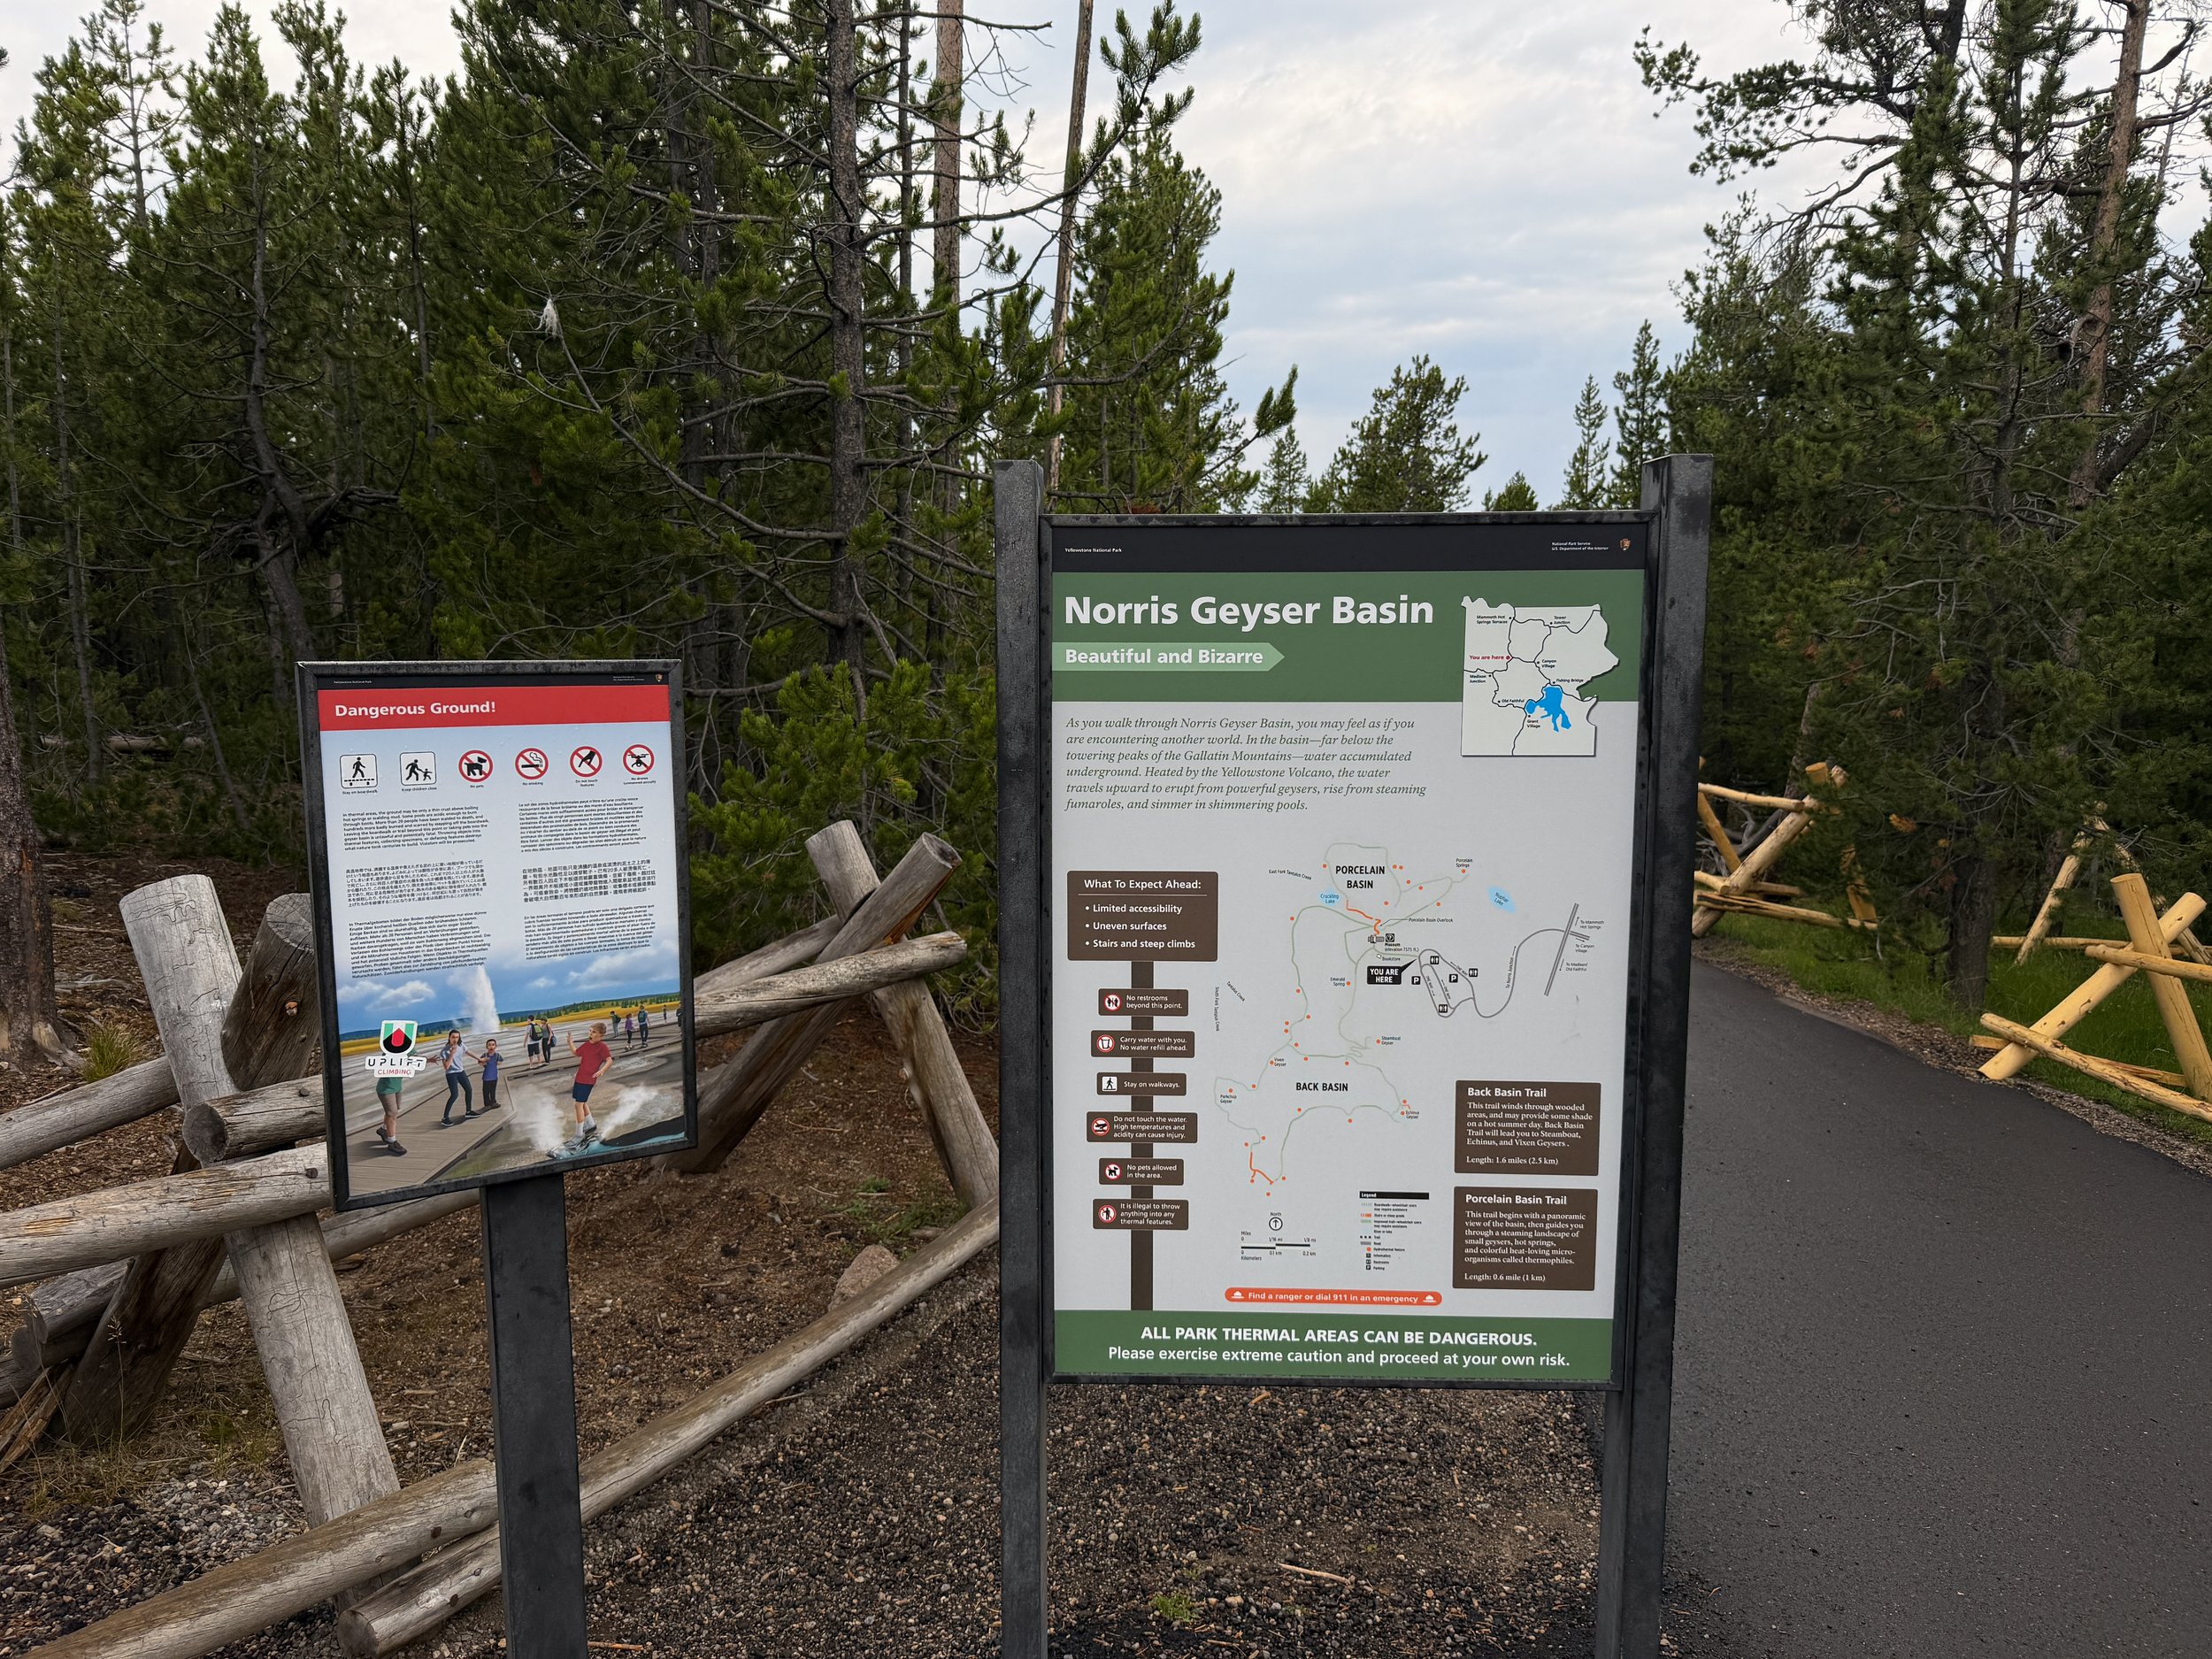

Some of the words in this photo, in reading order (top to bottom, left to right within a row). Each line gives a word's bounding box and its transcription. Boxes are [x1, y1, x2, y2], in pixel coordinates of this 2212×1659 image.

[1065, 595, 1179, 625] Norris
[1191, 596, 1321, 632] Geyser
[1333, 595, 1433, 624] Basin
[1066, 649, 1151, 664] Beautiful
[1157, 649, 1192, 664] and
[1199, 649, 1263, 664] Bizarre
[335, 705, 426, 718] Dangerous
[430, 701, 495, 714] Ground!
[1065, 718, 1079, 727] As
[1080, 720, 1102, 731] you
[1105, 718, 1133, 728] walk
[1134, 718, 1178, 731] through
[1180, 718, 1217, 728] Norris
[1219, 718, 1257, 731] Geyser
[1260, 718, 1294, 729] Basin,
[1295, 721, 1317, 732] you
[1320, 721, 1345, 732] may
[1345, 718, 1366, 732] feel
[1384, 718, 1394, 732] if
[1393, 721, 1415, 732] you
[1087, 734, 1159, 747] encountering
[1161, 734, 1205, 744] another
[1207, 734, 1243, 745] world.
[1246, 734, 1257, 744] In
[1260, 734, 1277, 745] the
[1340, 734, 1374, 745] below
[1376, 734, 1394, 745] the
[1066, 750, 1116, 764] towering
[1117, 750, 1148, 764] peaks
[1151, 750, 1164, 764] of
[1164, 750, 1181, 761] the
[1184, 750, 1229, 761] Gallatin
[1340, 751, 1412, 761] accumulated
[1067, 766, 1141, 780] underground.
[1145, 767, 1184, 777] Heated
[1186, 766, 1199, 780] by
[1202, 766, 1218, 777] the
[1222, 767, 1286, 777] Yellowstone
[1289, 767, 1334, 779] Volcano,
[1338, 767, 1355, 778] the
[1357, 769, 1391, 778] water
[1066, 782, 1103, 793] travels
[1106, 783, 1149, 795] upward
[1152, 784, 1163, 793] to
[1164, 785, 1194, 796] erupt
[1194, 783, 1224, 796] from
[1225, 783, 1277, 796] powerful
[1277, 786, 1320, 796] geysers,
[1324, 784, 1344, 794] rise
[1344, 783, 1373, 797] from
[1376, 784, 1427, 797] steaming
[1064, 798, 1124, 811] fumaroles,
[1127, 799, 1149, 809] and
[1151, 799, 1193, 810] simmer
[1195, 799, 1206, 810] in
[1208, 799, 1274, 812] shimmering
[1276, 800, 1308, 812] pools.
[1336, 865, 1385, 874] PORCELAIN
[1084, 879, 1112, 888] What
[1114, 879, 1126, 888] To
[1130, 879, 1163, 890] Expect
[1165, 879, 1201, 889] Ahead:
[1347, 880, 1373, 889] BASIN
[1129, 904, 1182, 915] accessibility
[1140, 941, 1164, 949] steep
[1167, 940, 1195, 949] climbs
[368, 1058, 424, 1067] UPLIFT
[1296, 1082, 1318, 1091] BACK
[1322, 1083, 1348, 1092] BASIN
[1468, 1087, 1492, 1096] Back
[1494, 1087, 1522, 1097] Basin
[1525, 1088, 1547, 1097] Trail
[1467, 1156, 1494, 1165] Length:
[1466, 1194, 1512, 1203] Porcelain
[1516, 1195, 1542, 1204] Basin
[1545, 1195, 1567, 1205] Trail
[1464, 1273, 1492, 1282] Length:
[1141, 1327, 1171, 1340] ALL
[1176, 1327, 1217, 1340] PARK
[1222, 1328, 1300, 1341] THERMAL
[1304, 1330, 1359, 1342] AREAS
[1363, 1331, 1399, 1343] CAN
[1404, 1332, 1424, 1344] BE
[1430, 1332, 1537, 1346] DANGEROUS.
[1110, 1346, 1155, 1359] Please
[1159, 1347, 1217, 1360] exercise
[1222, 1349, 1283, 1362] extreme
[1287, 1349, 1341, 1363] caution
[1347, 1350, 1374, 1363] and
[1380, 1351, 1439, 1366] proceed
[1443, 1353, 1458, 1364] at
[1463, 1356, 1497, 1367] your
[1502, 1356, 1534, 1365] own
[1540, 1353, 1570, 1366] risk.
